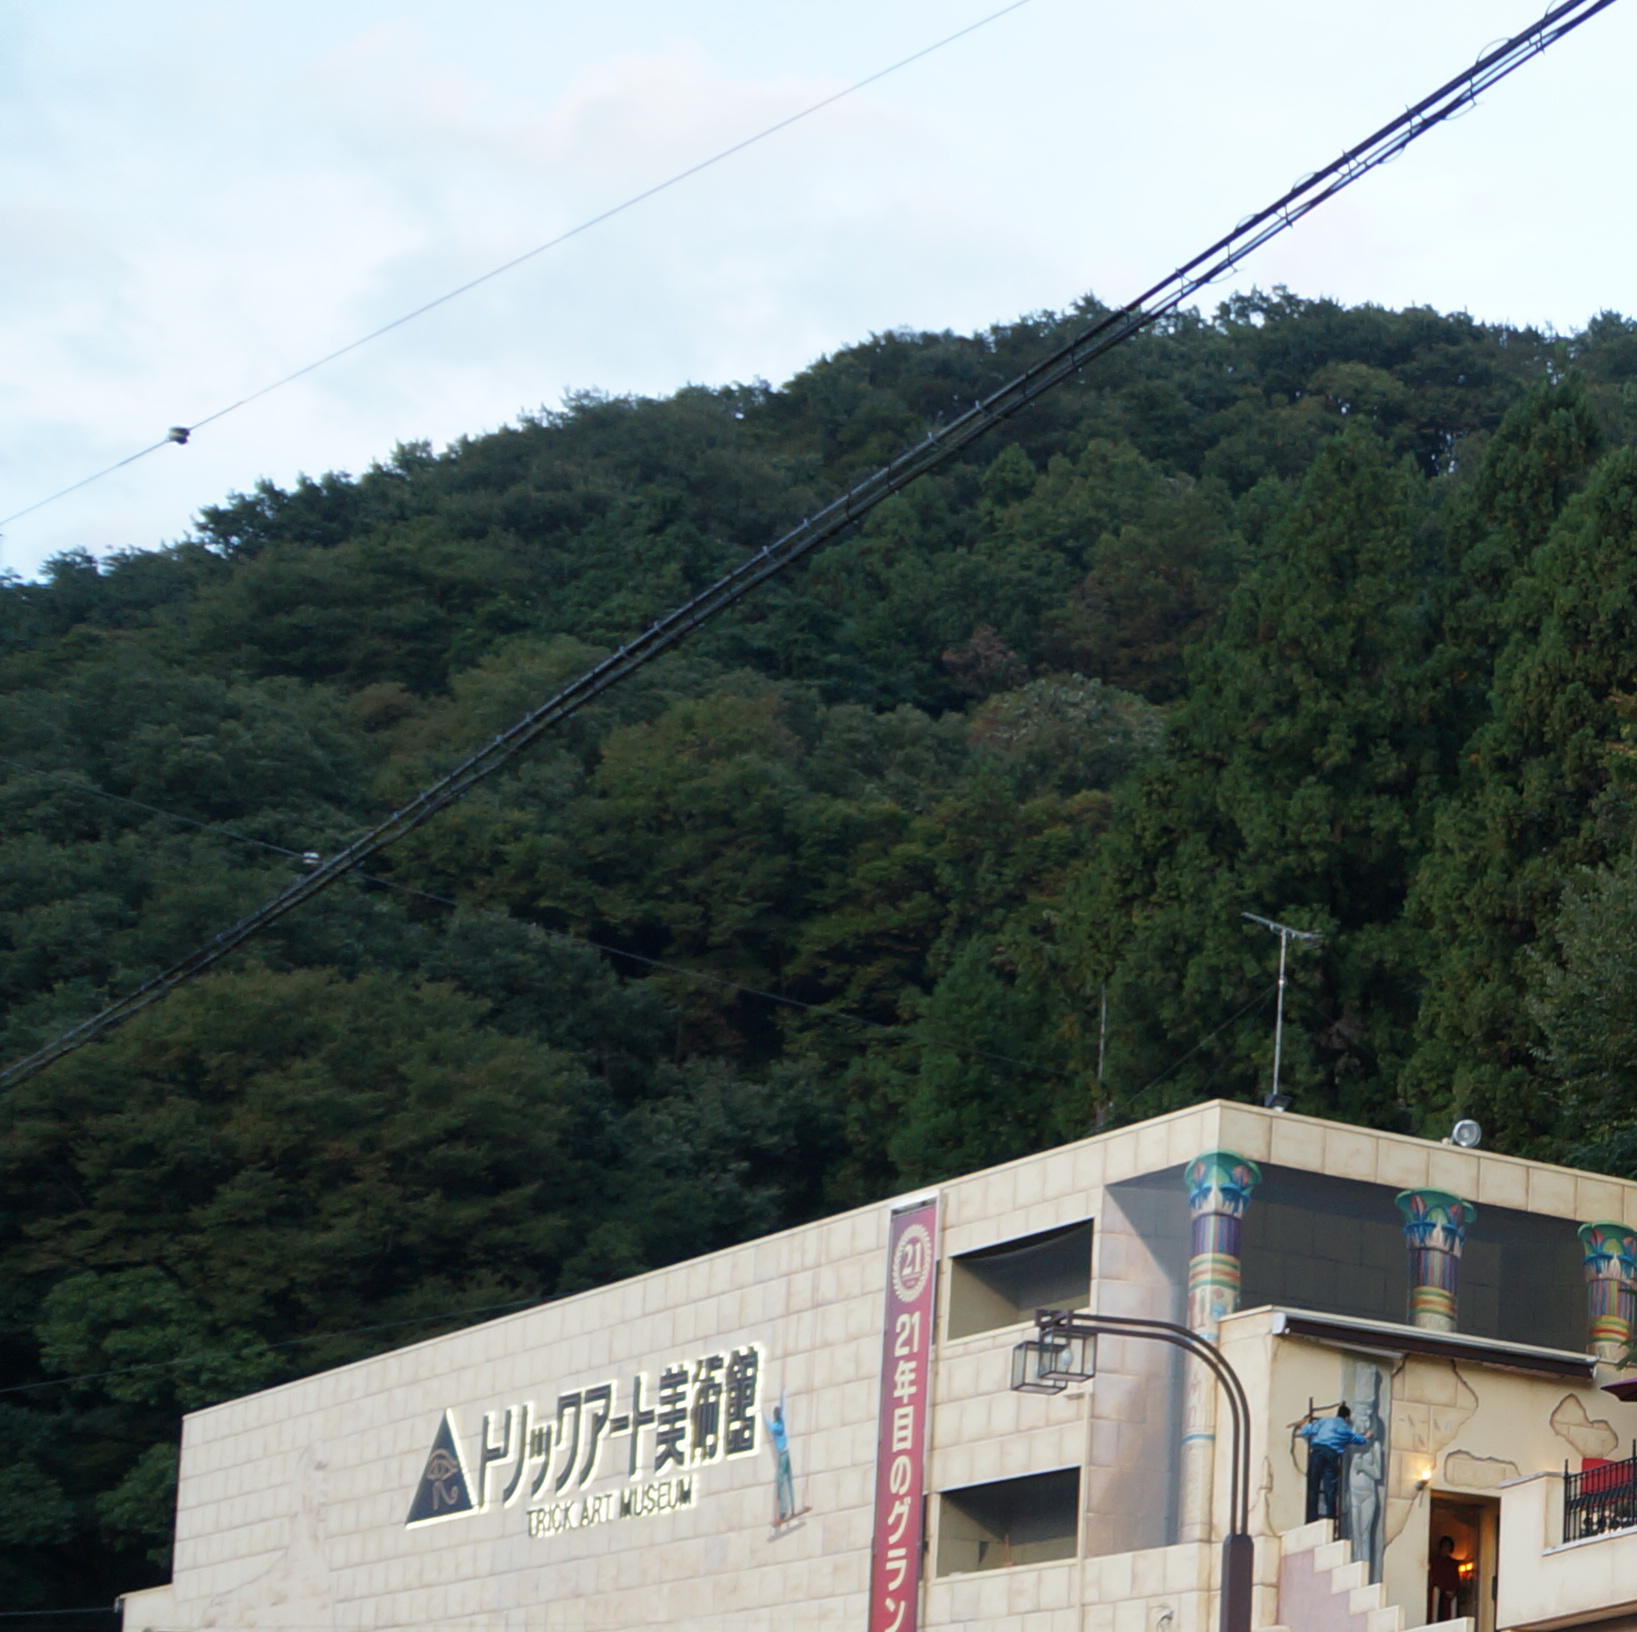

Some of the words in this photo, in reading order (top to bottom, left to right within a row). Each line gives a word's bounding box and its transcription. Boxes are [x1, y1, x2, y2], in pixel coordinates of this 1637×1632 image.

[479, 1344, 761, 1513] トリックアート美術館
[527, 1503, 573, 1537] TRICK
[580, 1494, 614, 1527] ART
[618, 1476, 698, 1519] MUSEUM
